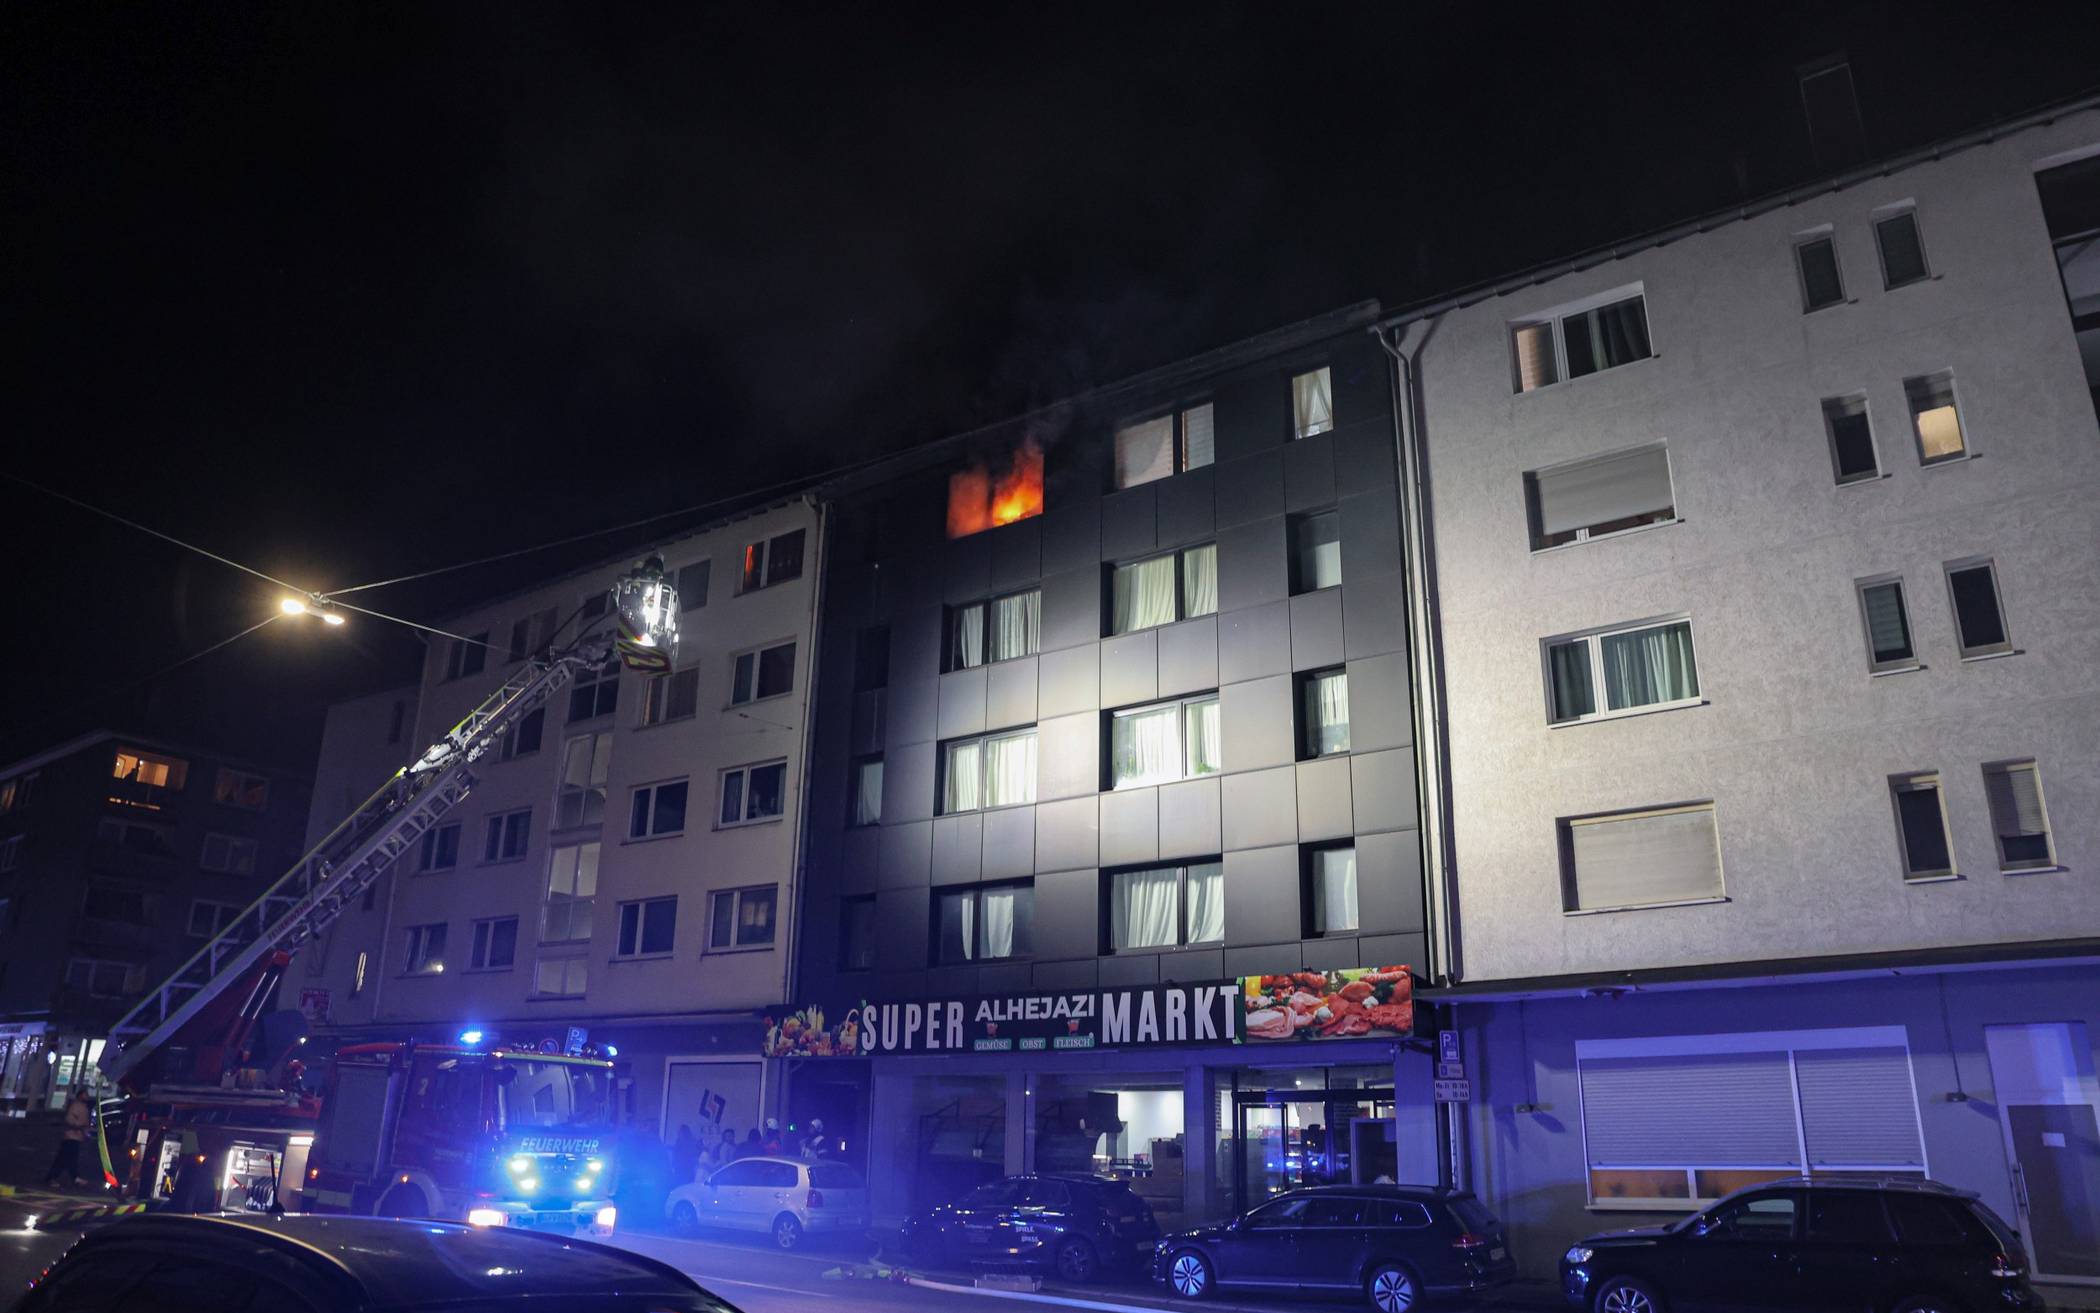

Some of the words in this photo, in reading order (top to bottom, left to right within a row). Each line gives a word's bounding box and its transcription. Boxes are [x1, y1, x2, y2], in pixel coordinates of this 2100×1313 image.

[861, 1001, 964, 1051] SUPER
[975, 994, 1095, 1022] ALHEJAZI
[1102, 985, 1239, 1043] MARKT
[976, 1039, 1009, 1050] GEMÜSE
[1022, 1038, 1044, 1049] OBST
[1055, 1037, 1091, 1048] FLEISCH
[1442, 1033, 1452, 1047] P
[520, 1137, 600, 1153] FEUERWEHR
